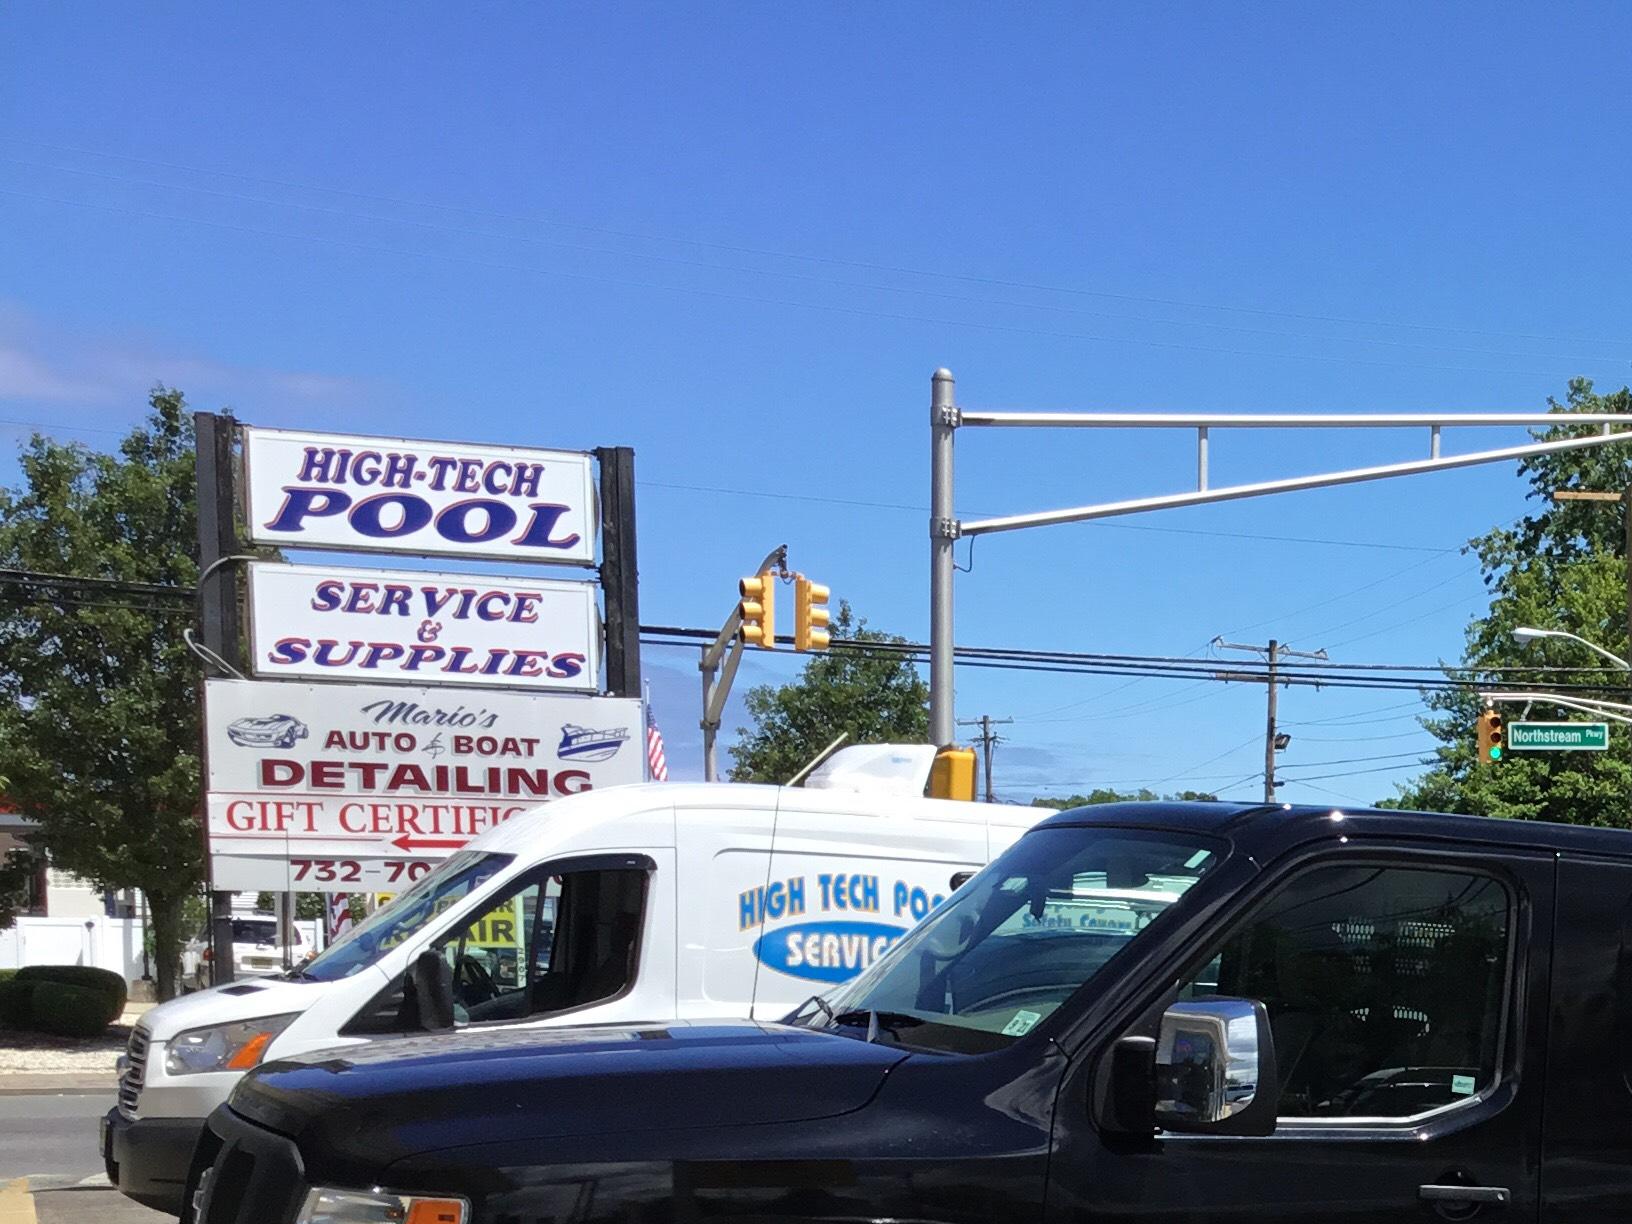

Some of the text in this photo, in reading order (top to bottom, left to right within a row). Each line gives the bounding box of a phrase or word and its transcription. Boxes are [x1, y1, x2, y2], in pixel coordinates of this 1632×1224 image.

[298, 446, 544, 497] HIGH-TECH
[264, 486, 581, 549] POOL
[311, 580, 543, 623] SERVICE
[417, 619, 441, 642] &
[268, 637, 586, 679] SUPPLIES
[361, 700, 499, 728] Mario's
[324, 730, 417, 753] AUTO
[454, 735, 540, 757] BOAT
[1513, 728, 1603, 743] Northstream Pkwy
[260, 758, 593, 796] DETAILING
[226, 801, 323, 832] GIFT
[739, 876, 805, 932] HIGH
[818, 873, 880, 913] TECH
